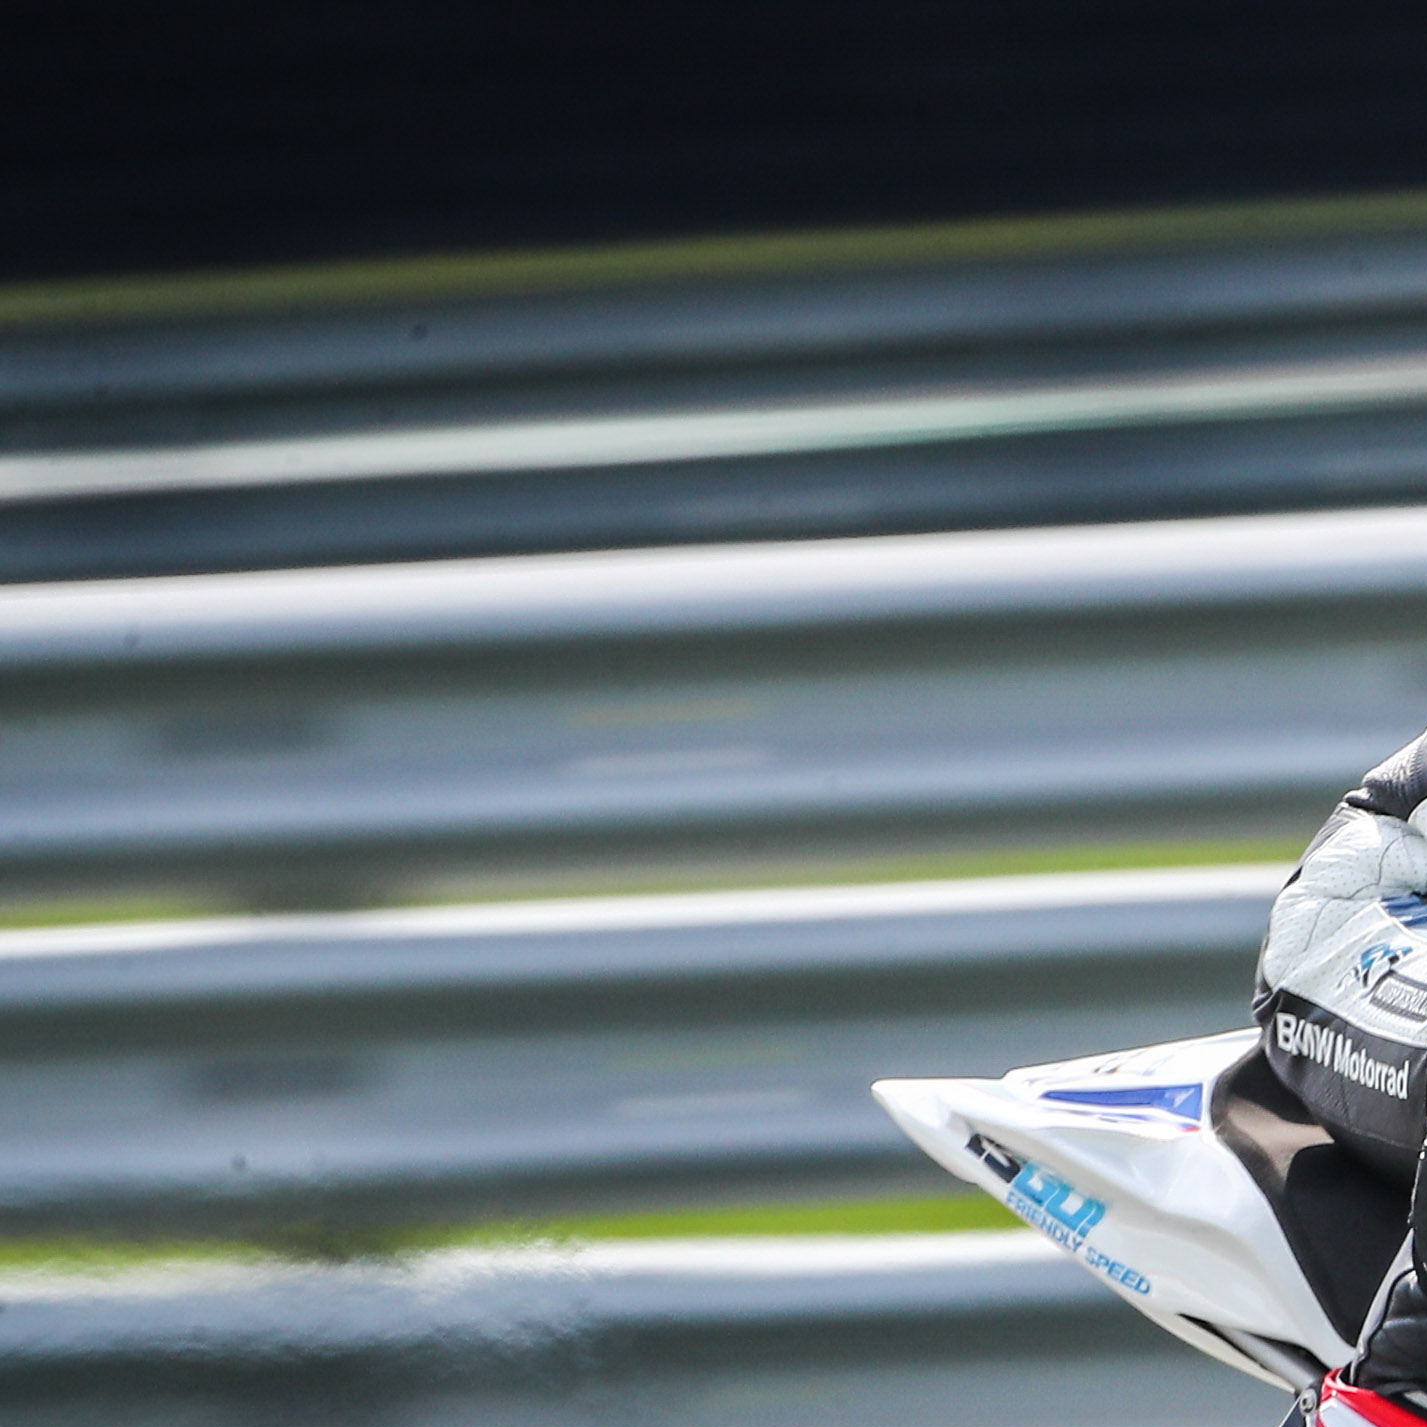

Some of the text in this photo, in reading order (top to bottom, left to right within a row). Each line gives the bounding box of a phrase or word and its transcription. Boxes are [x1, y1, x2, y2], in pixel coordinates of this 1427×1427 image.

[1332, 1033, 1410, 1100] Motorrad
[1006, 1191, 1084, 1253] FRIENDLY
[1084, 1246, 1151, 1295] SPEED
